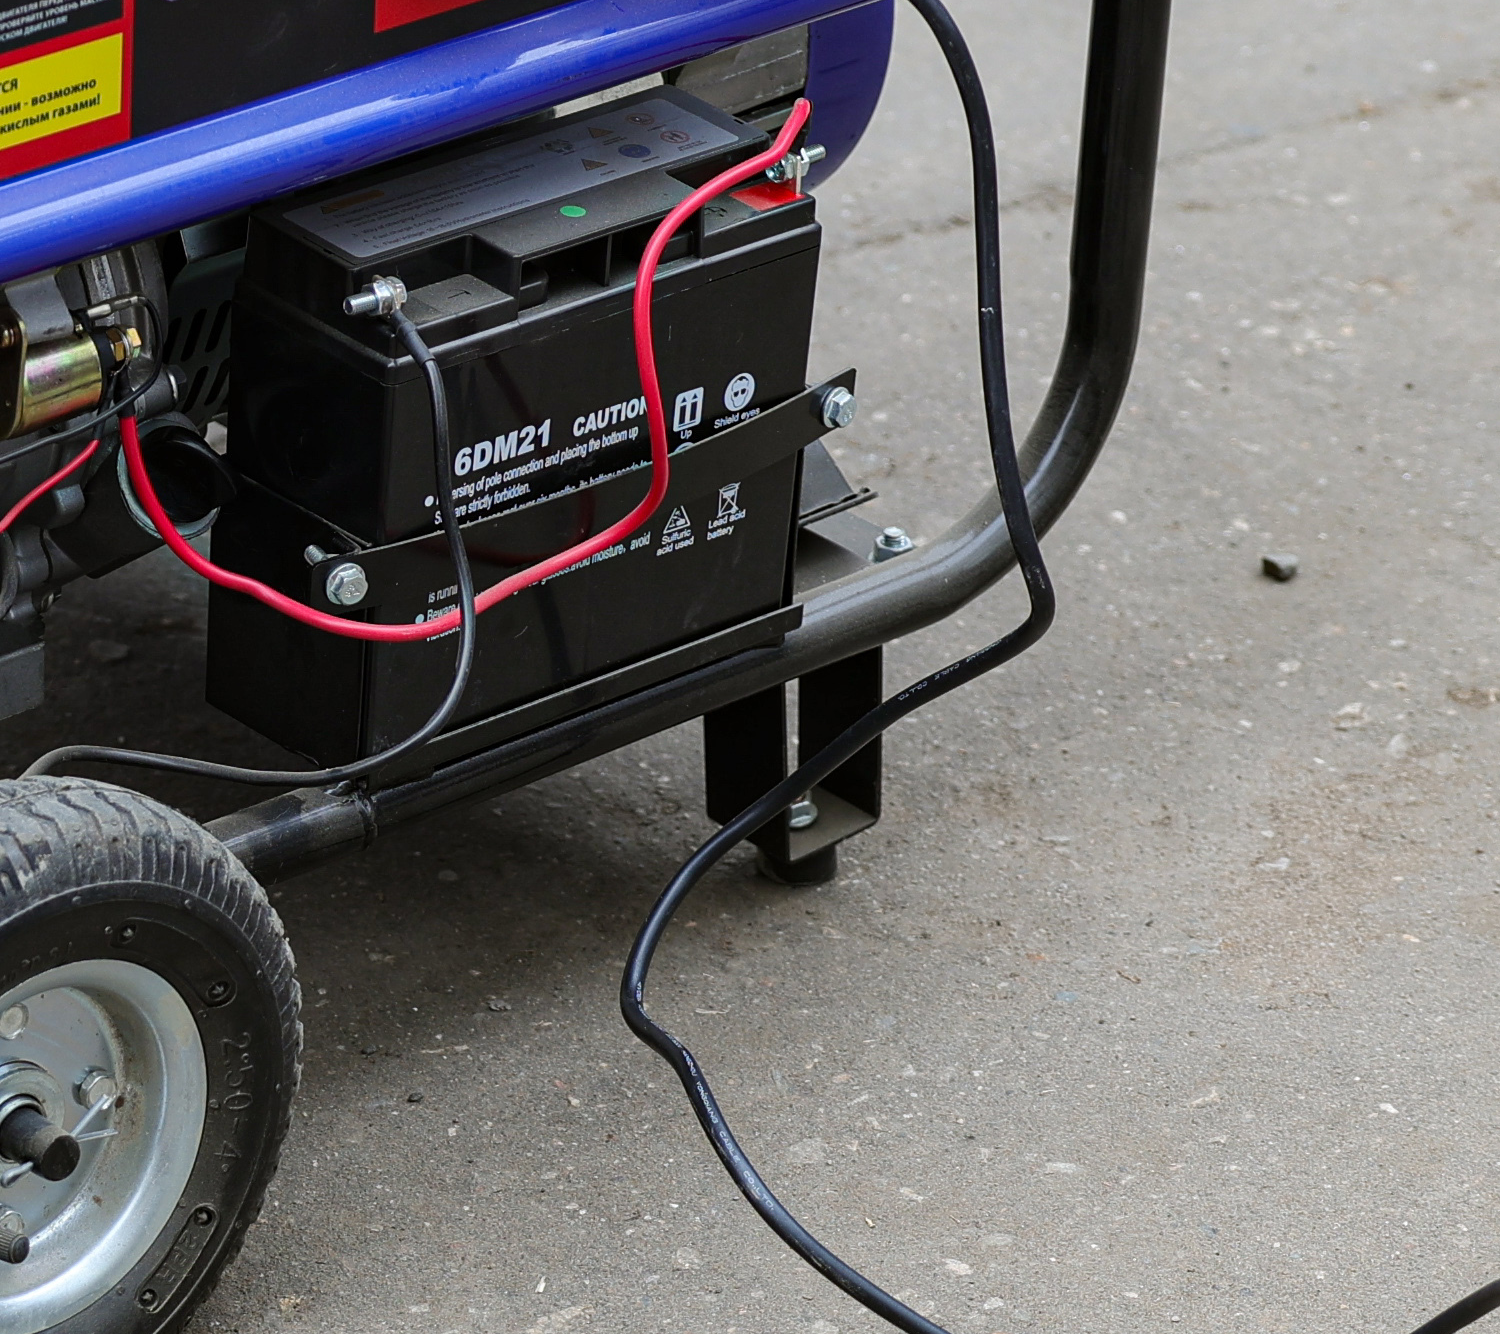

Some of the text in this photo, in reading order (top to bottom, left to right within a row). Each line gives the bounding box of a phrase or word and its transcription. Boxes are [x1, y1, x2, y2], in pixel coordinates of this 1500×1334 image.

[30, 78, 97, 107] возможно
[52, 93, 100, 119] газами!
[714, 407, 760, 430] Shield eyes
[680, 430, 692, 440] Up
[454, 418, 551, 476] 6DM21
[476, 426, 639, 492] of pole connection and placing the bottom up
[468, 496, 492, 515] strictly
[494, 482, 531, 504] forbidden.
[708, 509, 746, 530] Lead acid
[630, 531, 651, 551] avoid
[662, 529, 692, 546] Sulfuric
[707, 525, 735, 541] battery
[656, 536, 695, 557] acid used
[428, 592, 435, 604] is
